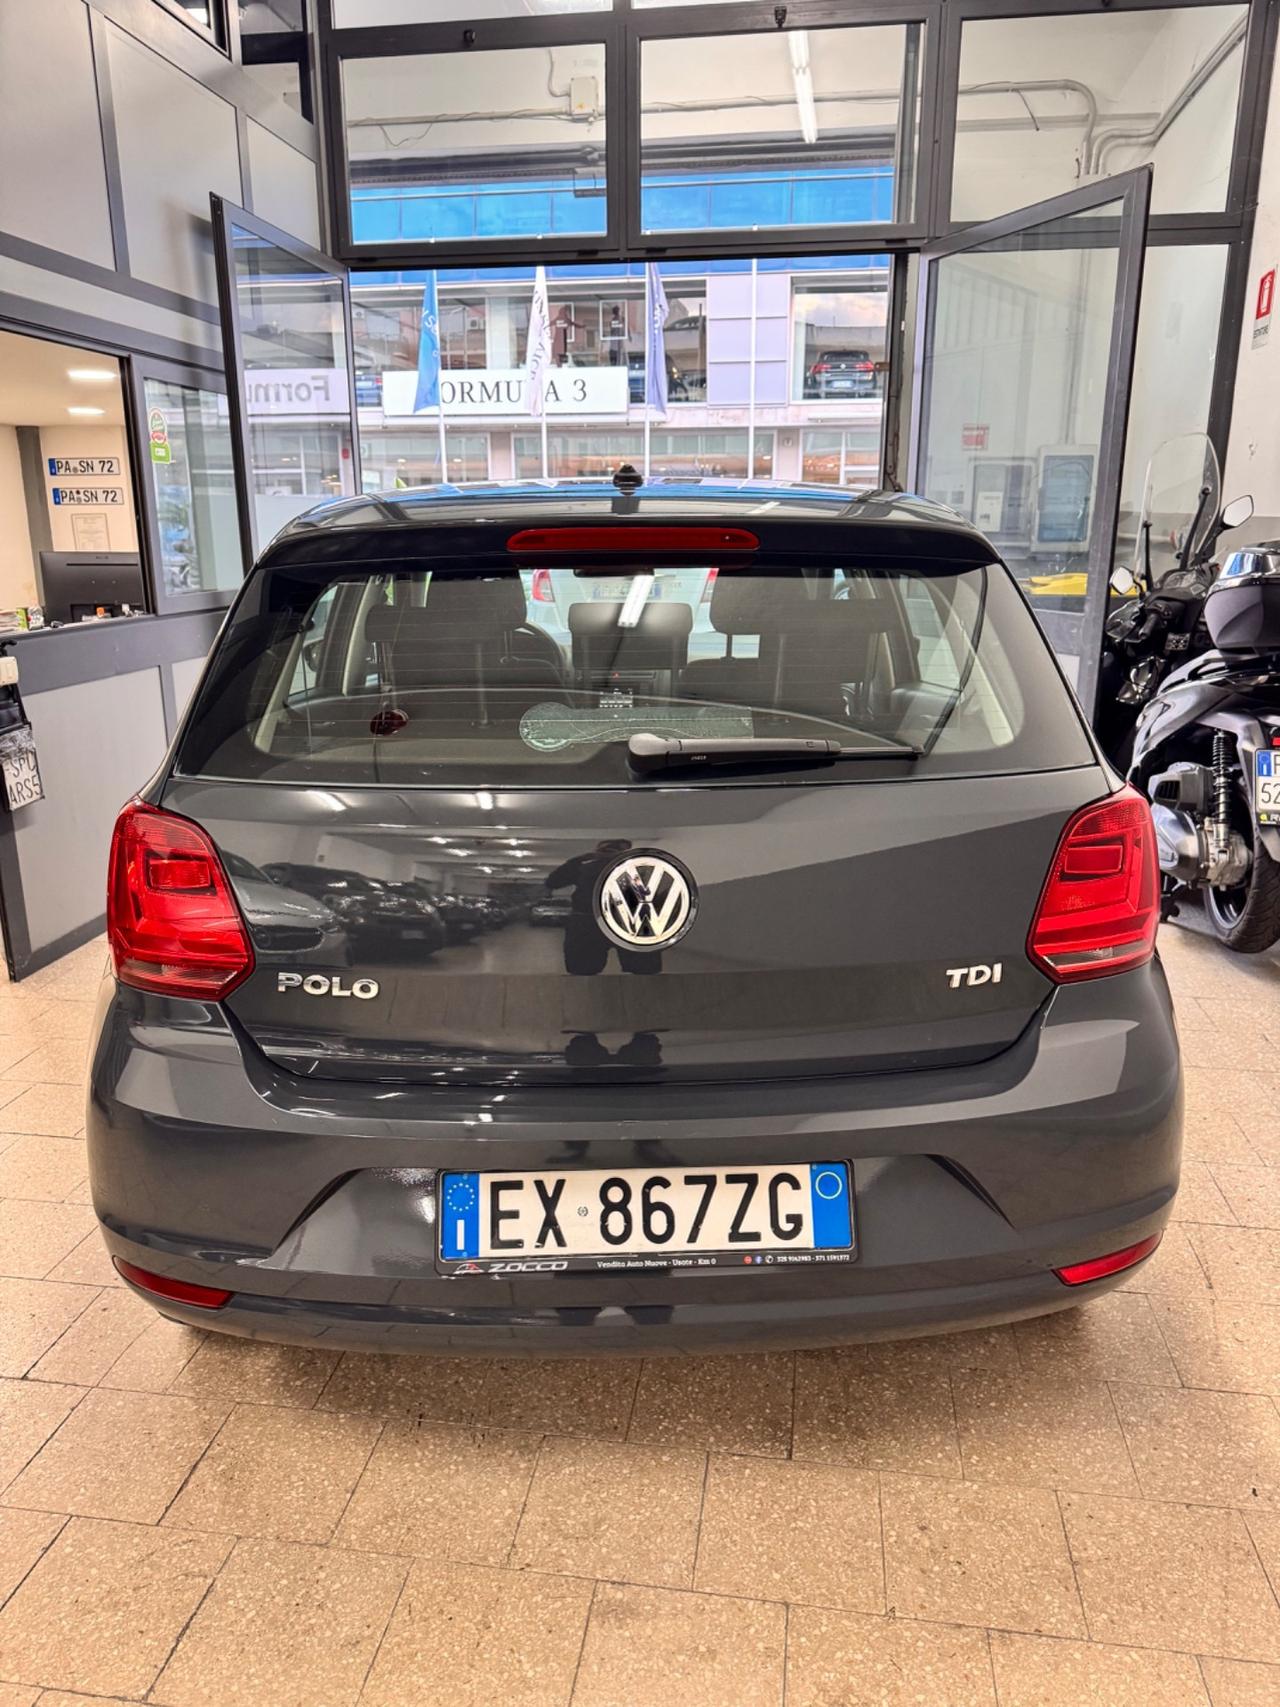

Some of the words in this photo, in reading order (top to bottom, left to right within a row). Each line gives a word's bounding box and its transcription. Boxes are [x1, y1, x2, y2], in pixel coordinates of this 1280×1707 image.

[440, 379, 562, 405] ORMUA
[573, 378, 587, 401] 3
[56, 460, 72, 473] PA
[79, 460, 94, 473] SN
[99, 460, 114, 473] 72
[60, 490, 76, 503] PA
[83, 490, 98, 503] SN
[102, 490, 118, 503] 72
[277, 971, 379, 999] POLO
[945, 962, 1003, 988] TDI
[490, 1178, 567, 1250] EX
[599, 1172, 803, 1246] 867ZG
[487, 1261, 569, 1273] ZOCCO
